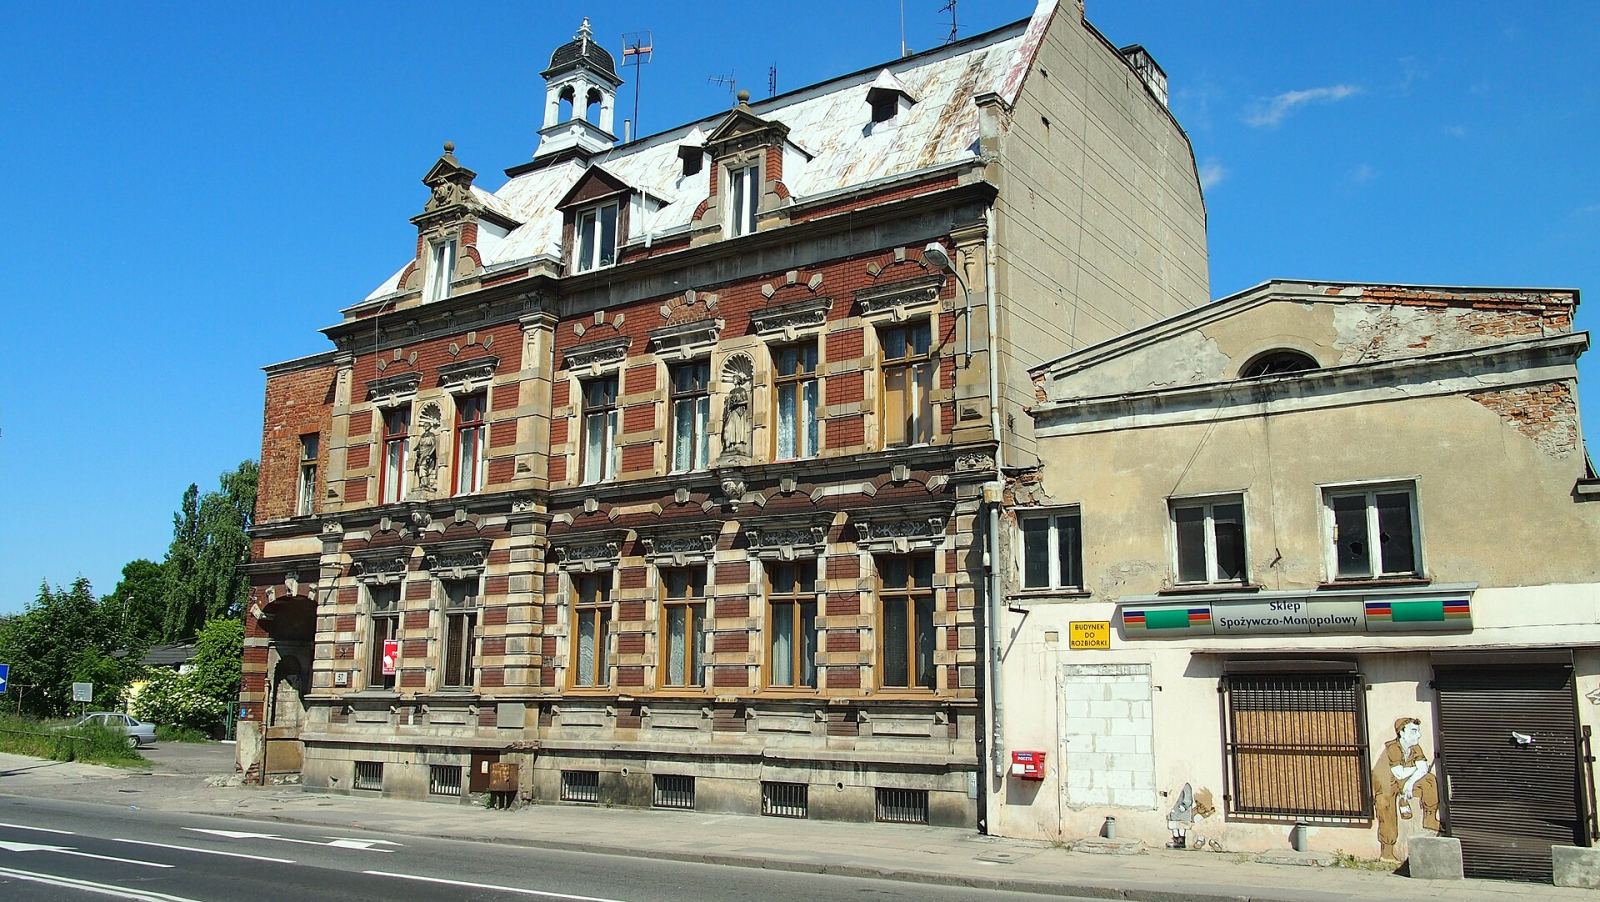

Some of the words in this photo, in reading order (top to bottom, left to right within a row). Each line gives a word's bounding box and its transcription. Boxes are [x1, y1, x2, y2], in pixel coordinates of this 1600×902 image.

[1269, 601, 1301, 613] Sklep
[1074, 623, 1105, 631] BUDYNEK
[1220, 614, 1358, 629] Spożywczo-Monopolowy
